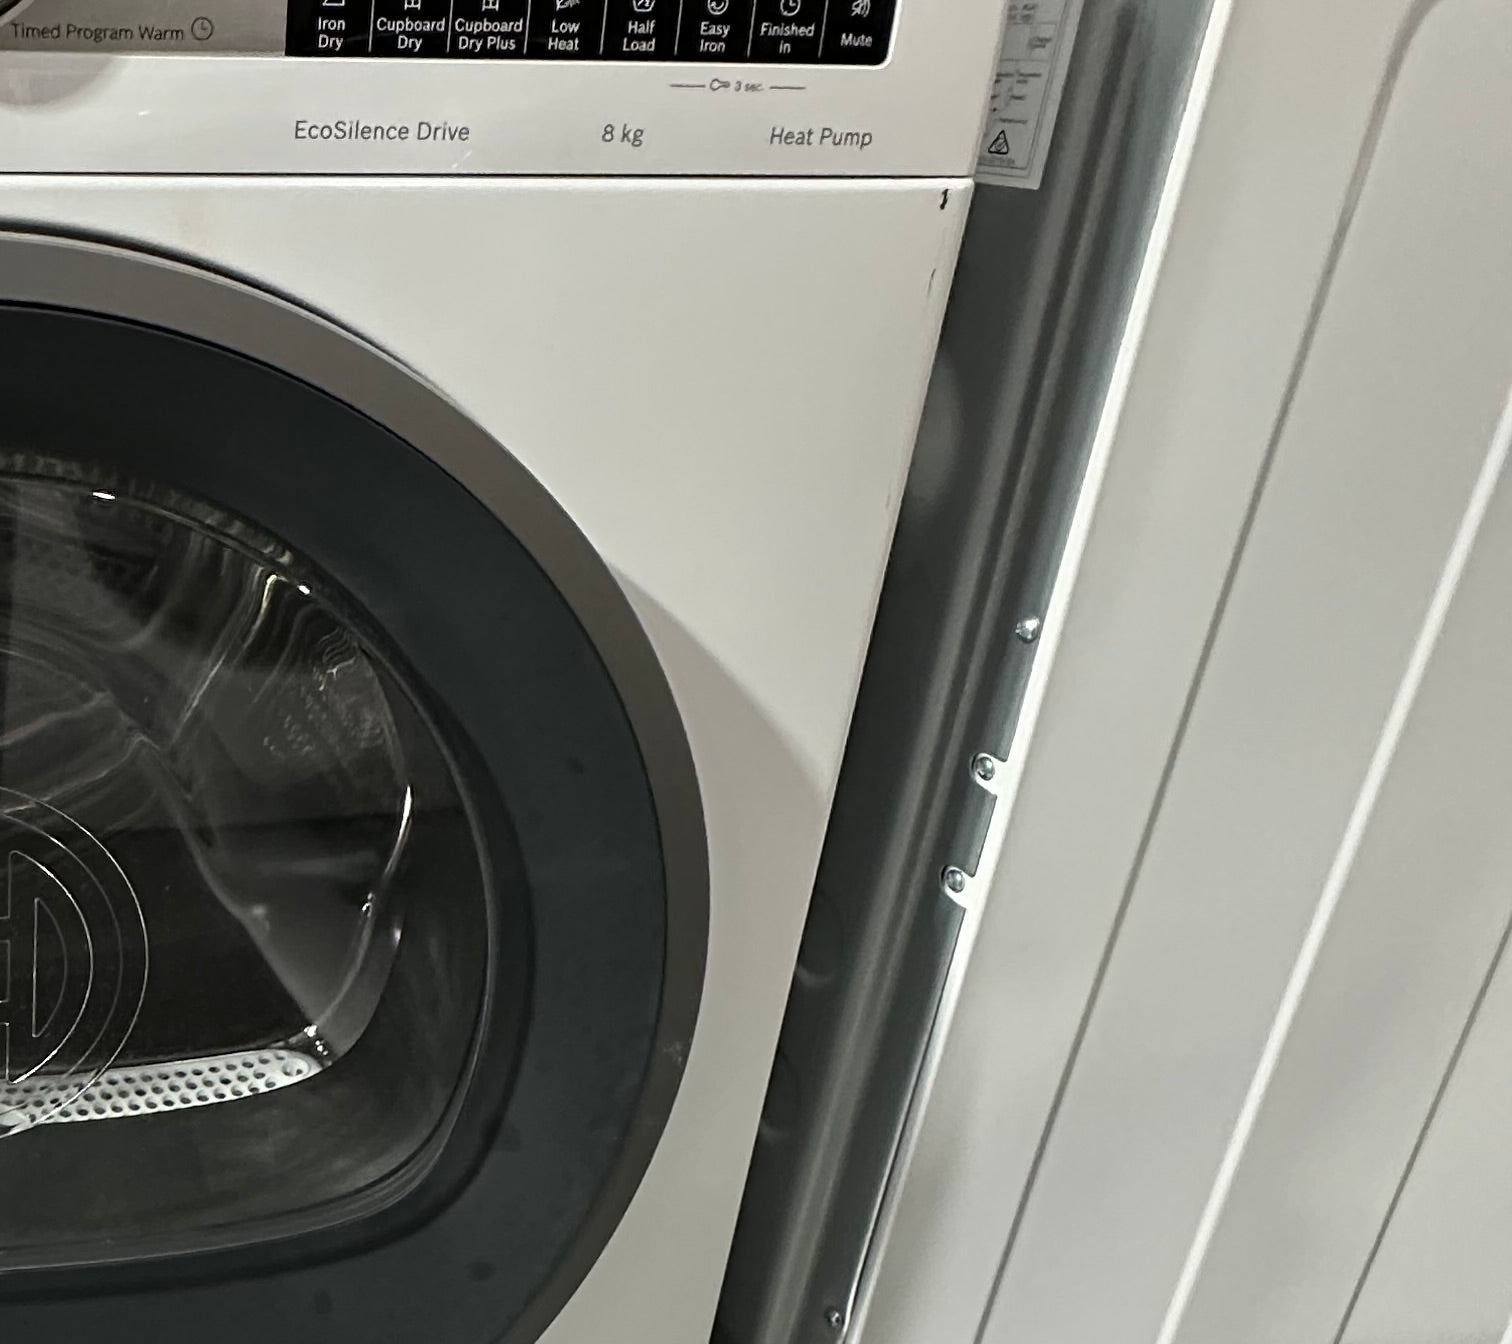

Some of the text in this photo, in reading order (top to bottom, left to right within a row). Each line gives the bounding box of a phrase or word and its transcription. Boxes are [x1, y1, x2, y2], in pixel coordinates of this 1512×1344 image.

[318, 17, 345, 31] Iron
[377, 17, 445, 35] Cupboard
[454, 18, 523, 35] Cupboard
[551, 19, 581, 33] Low
[628, 20, 656, 34] Half
[700, 22, 730, 38] Easy
[760, 22, 816, 37] Finished
[11, 22, 185, 43] Timed Program Warm
[840, 32, 873, 47] Mute
[318, 34, 343, 50] Dry
[397, 36, 423, 53] Dry
[458, 36, 516, 52] Dry Plus
[548, 37, 579, 51] Heat
[622, 37, 656, 52] Load
[699, 39, 726, 53] Iron
[779, 40, 792, 54] in
[734, 80, 742, 92] 3
[294, 119, 470, 141] EcoSilence Drive
[601, 123, 644, 147] 8 kg
[769, 126, 874, 150] Heat Pump
